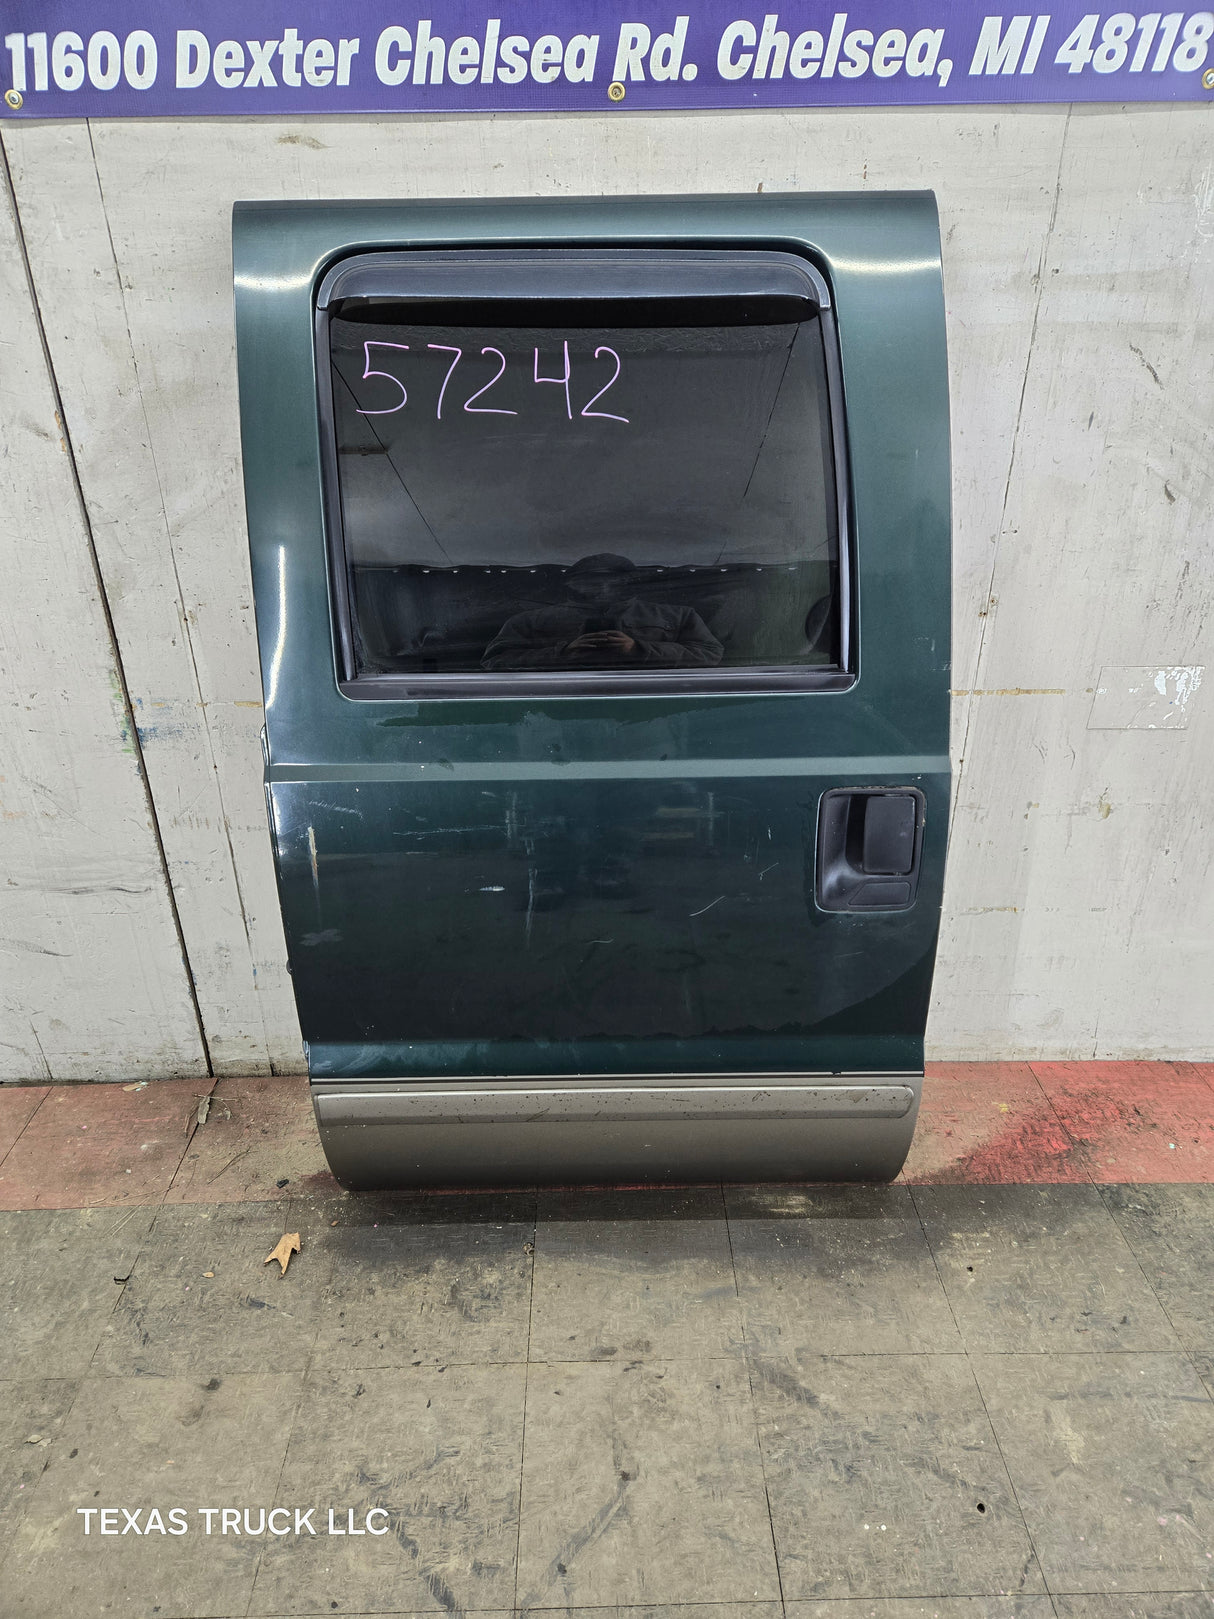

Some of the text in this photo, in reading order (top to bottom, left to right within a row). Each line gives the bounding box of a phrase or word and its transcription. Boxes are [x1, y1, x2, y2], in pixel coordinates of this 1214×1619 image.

[4, 12, 1214, 92] 11600 Dexter Chelsea Rd. Chelsea, MI 48118
[355, 340, 630, 423] 57242
